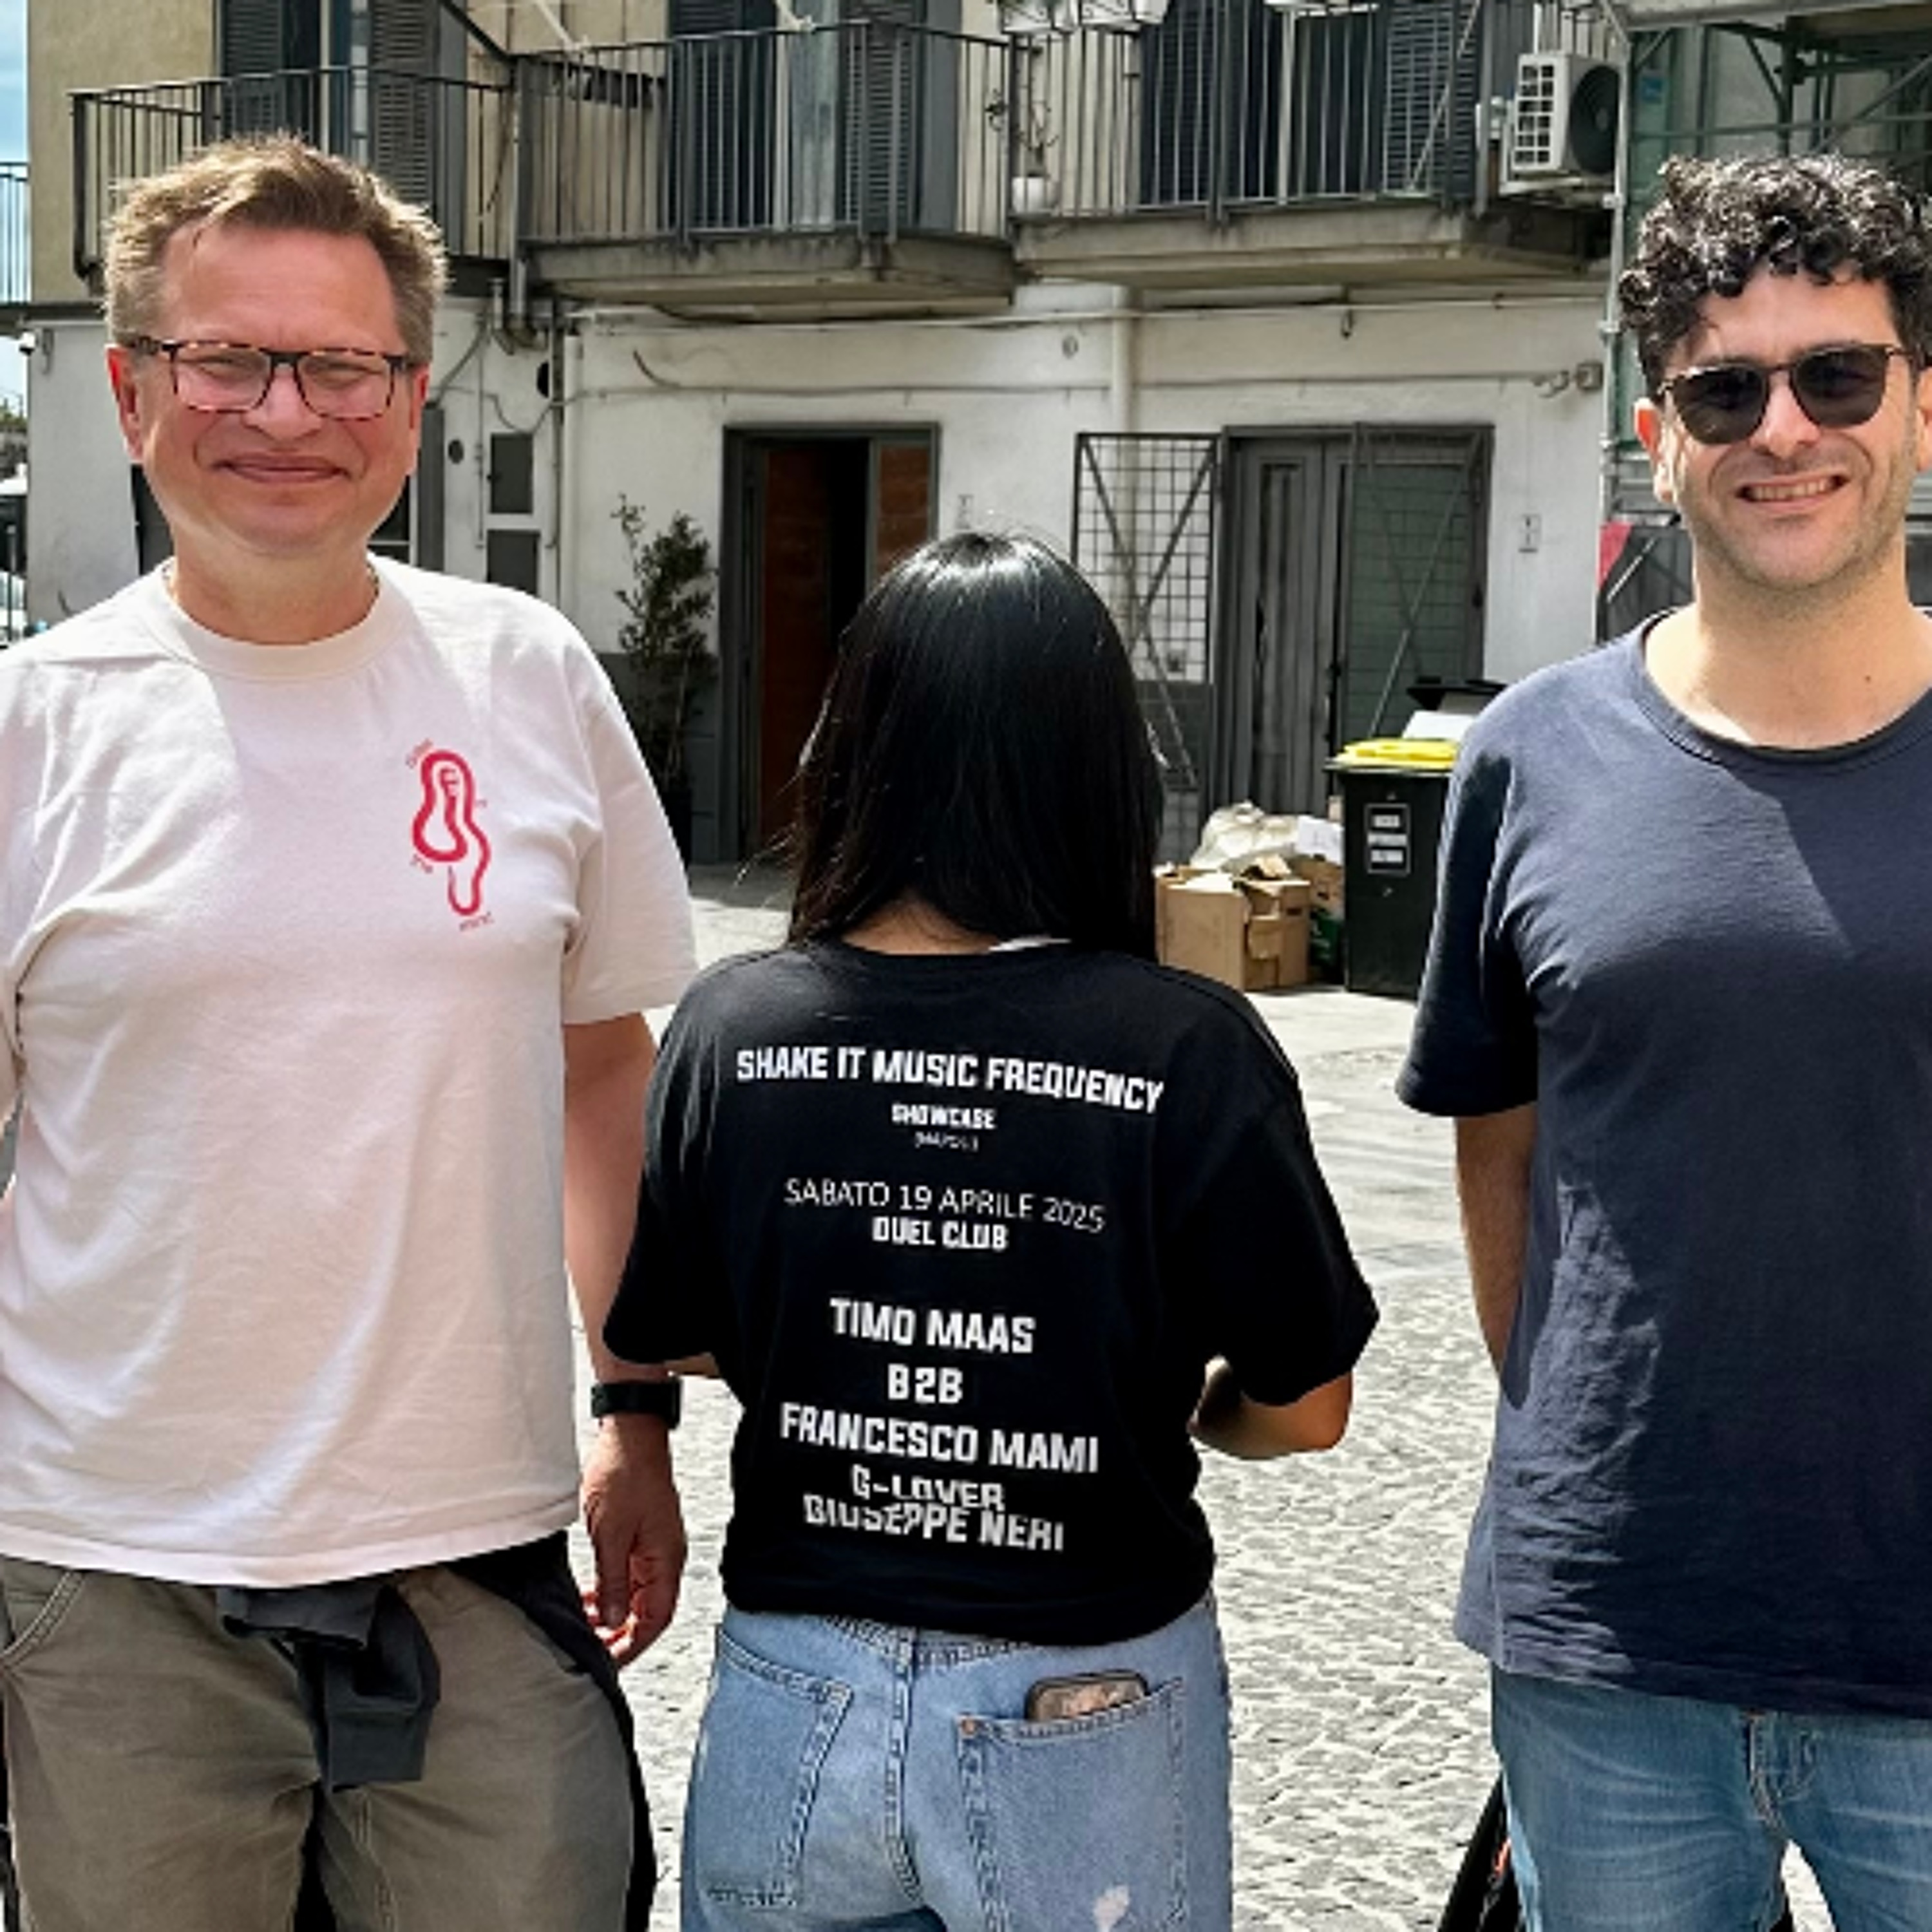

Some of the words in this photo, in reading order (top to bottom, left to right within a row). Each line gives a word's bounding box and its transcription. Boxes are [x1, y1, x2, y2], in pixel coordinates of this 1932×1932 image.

[737, 1046, 829, 1081] SHAKE
[837, 1046, 866, 1079] IT
[872, 1050, 978, 1087] MUSIC
[985, 1057, 1164, 1114] FREQUENCY
[891, 1103, 996, 1130] SHOWCASE
[784, 1178, 890, 1207] SABATO
[900, 1185, 932, 1211] 19
[938, 1188, 1034, 1220] APRILE
[1043, 1197, 1104, 1234] 2025
[872, 1216, 936, 1246] DUEL
[942, 1220, 1009, 1251] CLUB
[829, 1298, 916, 1346] TIMO
[926, 1309, 1036, 1353] MAAS
[887, 1363, 963, 1404] B2B
[781, 1402, 978, 1463] FRANCESCO
[989, 1429, 1099, 1473] MAMI
[851, 1464, 1005, 1511] G-LOVER
[802, 1493, 971, 1543] GIUSEPPE
[978, 1511, 1064, 1551] NERI
